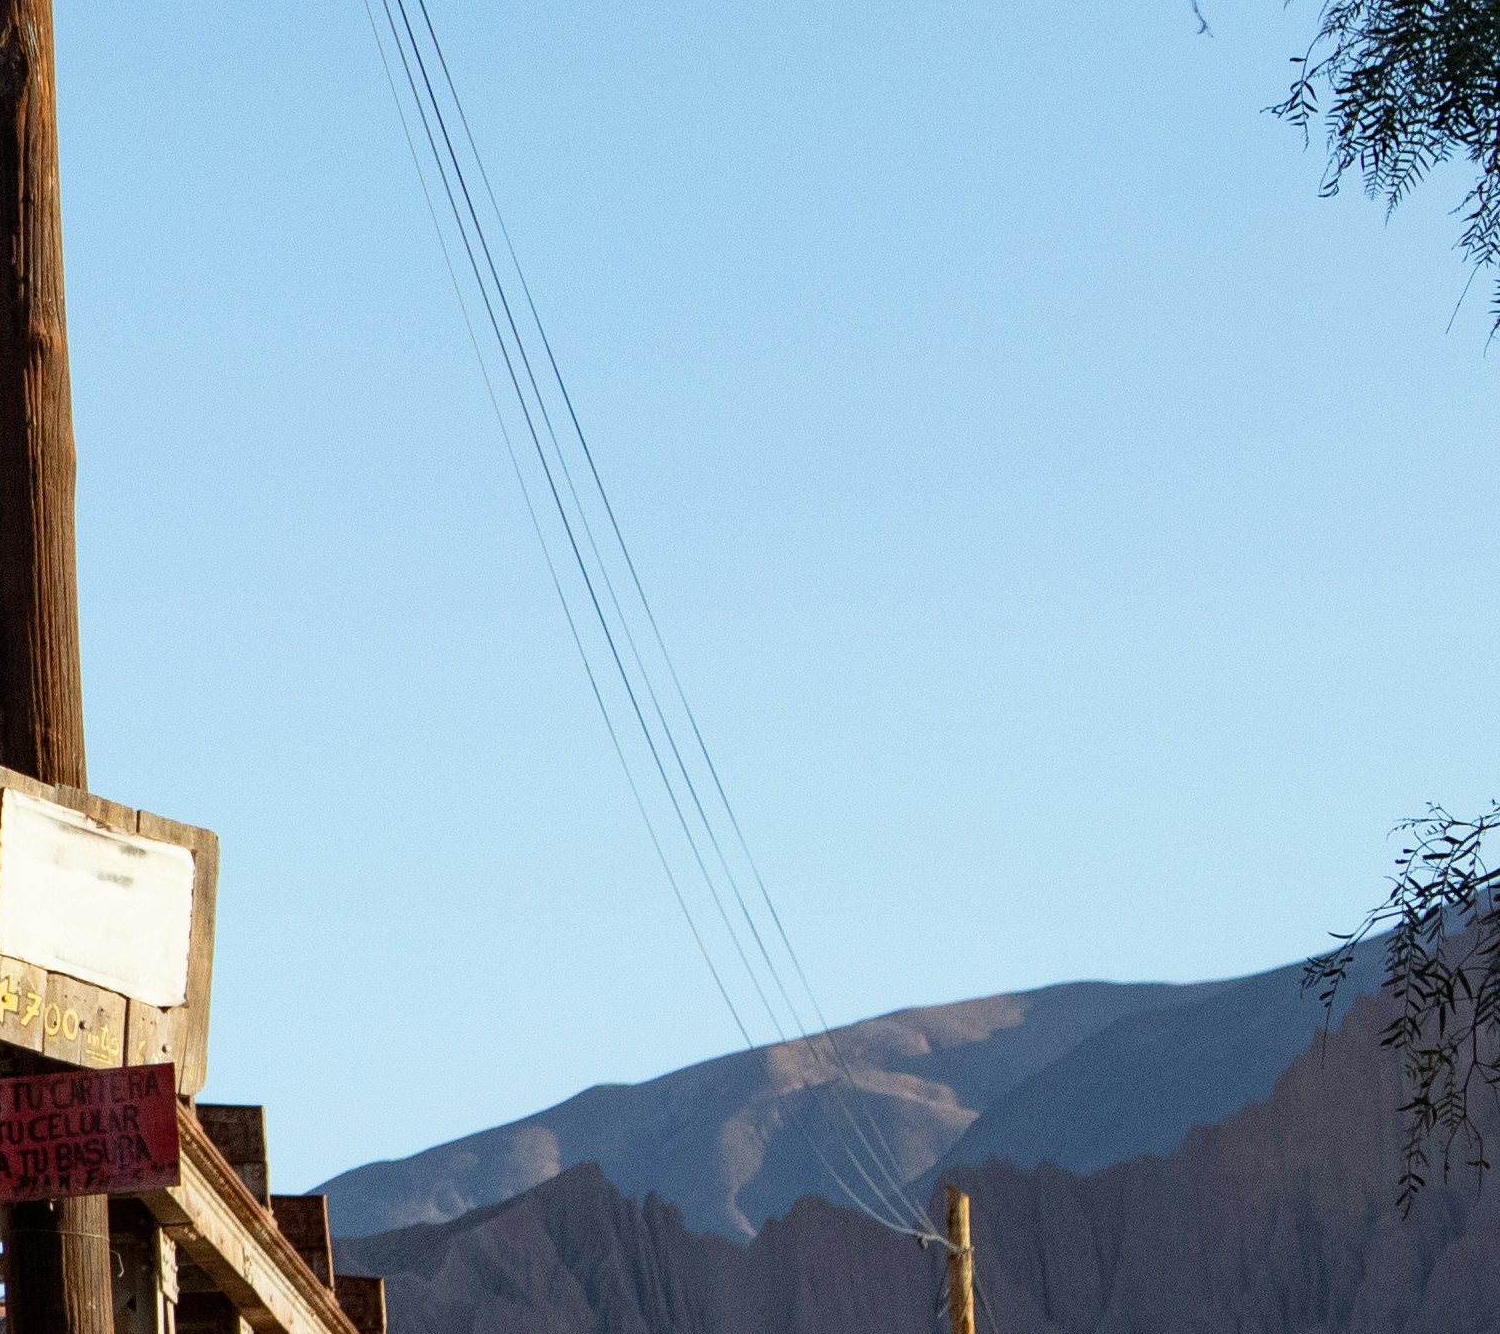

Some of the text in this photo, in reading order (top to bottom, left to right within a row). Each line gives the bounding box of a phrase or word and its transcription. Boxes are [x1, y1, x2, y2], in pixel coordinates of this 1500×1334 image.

[20, 992, 79, 1041] 700
[10, 1081, 42, 1113] TU
[50, 1070, 161, 1110] CARTERA
[28, 1104, 140, 1144] CELULAR
[16, 1147, 49, 1177] TU
[55, 1134, 153, 1174] BASURA
